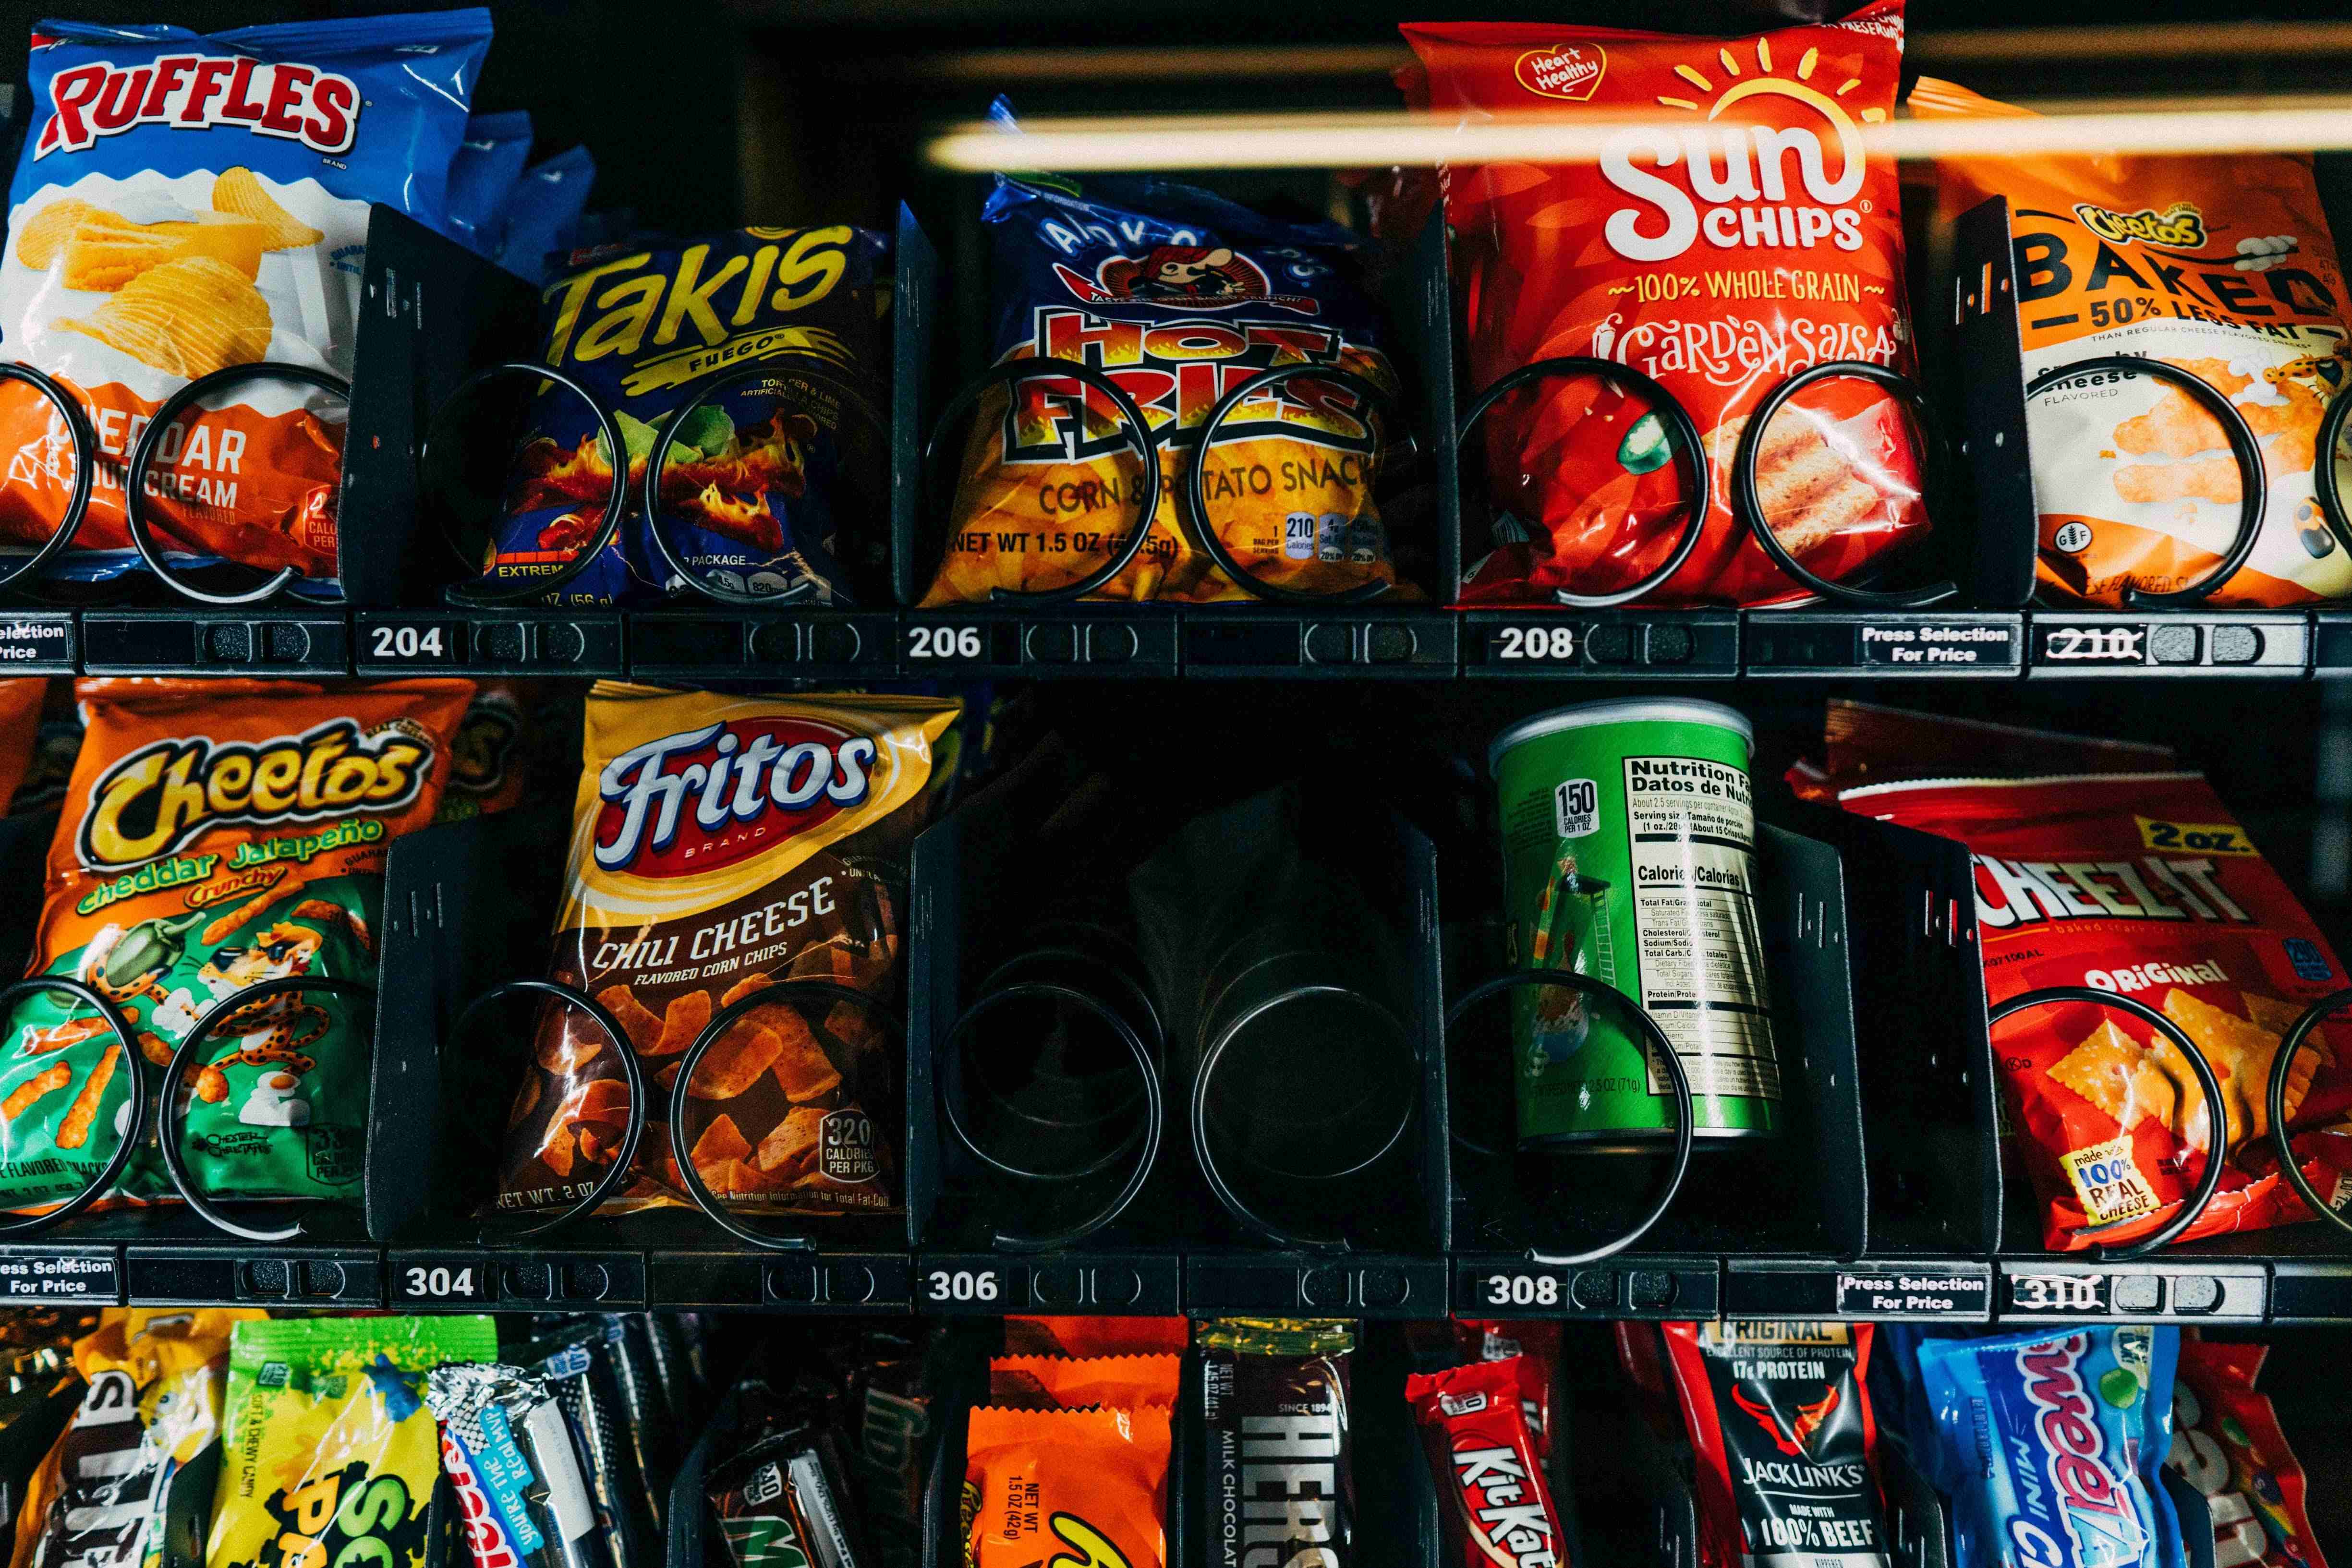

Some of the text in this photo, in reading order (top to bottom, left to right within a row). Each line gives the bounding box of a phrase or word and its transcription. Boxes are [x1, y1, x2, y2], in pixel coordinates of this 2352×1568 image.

[1530, 47, 1581, 73] Heart
[1535, 54, 1599, 91] Healthy
[35, 55, 359, 159] RUFFLES
[322, 158, 347, 170] BRAND
[1599, 122, 1867, 262] Sun
[1703, 206, 1863, 252] CHIPS
[2075, 203, 2206, 250] Cheetos
[1636, 271, 1860, 303] 100% WHOLE GRAIN
[2016, 235, 2339, 317] BAKED
[537, 225, 853, 396] Takis
[2092, 296, 2302, 340] 50% LESS FAT
[1043, 310, 1337, 368] HOT
[2091, 333, 2122, 342] THAN
[2127, 327, 2176, 336] REGULAR
[689, 336, 774, 373] FUEGO
[1012, 361, 1370, 450] FRIES
[2045, 388, 2118, 407] FLAVORED
[145, 470, 237, 509] CREAM
[1039, 478, 1120, 515] CORN
[1130, 482, 1145, 506] &
[183, 504, 237, 526] FLAVORED
[1286, 518, 1314, 538] 210
[314, 535, 336, 548] PER
[951, 532, 1100, 555] NET WT 1.5 OZ
[1273, 526, 1278, 538] 1
[1286, 540, 1314, 550] Calories
[2059, 530, 2087, 545] G F
[691, 555, 746, 567] PACKAGE
[1321, 552, 1334, 560] 20%
[372, 627, 442, 656] 204
[909, 627, 980, 657] 206
[1499, 627, 1573, 658] 208
[1862, 627, 2008, 641] Press Selection
[2058, 627, 2135, 659] 210
[1892, 647, 1977, 662] For Price
[1631, 760, 1735, 784] Nutrition
[86, 725, 430, 868] Cheetos
[595, 720, 876, 872] Fritos
[1558, 782, 1595, 817] 150
[1632, 777, 1722, 796] Datos de
[1633, 798, 1703, 811] About 2.5 servings per
[1564, 814, 1591, 826] CALORIES
[1564, 825, 1576, 834] PER
[1582, 822, 1592, 832] OZ.
[1634, 811, 1744, 830] Serving de porción
[1643, 822, 1723, 834] (1 15
[229, 818, 385, 870] Jalapeño
[685, 827, 768, 859] BRAND
[77, 854, 218, 915] cheddar
[185, 865, 286, 907] Crunchy
[592, 877, 836, 969] CHILI CHEESE
[2056, 924, 2102, 935] baked
[634, 941, 788, 985] FLAVORED CORN CHIPS
[1706, 950, 1728, 959] totales
[1604, 1076, 1640, 1094] OZ (71g)
[828, 1118, 871, 1146] 320
[826, 1147, 874, 1160] CALORIES
[829, 1160, 874, 1174] PER PKG
[2074, 1150, 2103, 1167] made
[9, 1158, 67, 1178] FLAVORED
[2078, 1158, 2131, 1188] 100%
[526, 1187, 561, 1204] WT.
[563, 1185, 575, 1199] 2
[711, 1190, 855, 1205] See Nutrition Information for Total
[2099, 1194, 2150, 1220] CHEESE
[0, 1260, 112, 1285] ess Selection
[10, 1279, 86, 1293] For Price
[406, 1267, 473, 1296] 304
[929, 1271, 997, 1300] 306
[1843, 1277, 1984, 1291] Press Selection
[1488, 1275, 1558, 1304] 308
[1873, 1295, 1953, 1309] For Price
[2024, 1279, 2096, 1310] 310
[1758, 1347, 1853, 1359] SOURCE OF PROTEIN
[1220, 1363, 1233, 1380] NET
[1757, 1361, 1825, 1379] PROTEIN
[251, 1394, 263, 1416] SOFT
[1278, 1403, 1308, 1413] SINCE
[485, 1411, 508, 1443] MVP
[246, 1428, 260, 1462] CHEWY
[239, 1465, 255, 1499] CANDY
[1743, 1458, 1863, 1488] JACK LINK'S
[2011, 1435, 2050, 1521] MINI
[1003, 1475, 1023, 1541] 1.5 OZ (42g)
[1025, 1483, 1039, 1533] NET WT
[1222, 1430, 1237, 1568] MILK CHOCOLAT
[1789, 1504, 1835, 1517] MADE WITH
[1761, 1518, 1874, 1547] 100% BEEF
